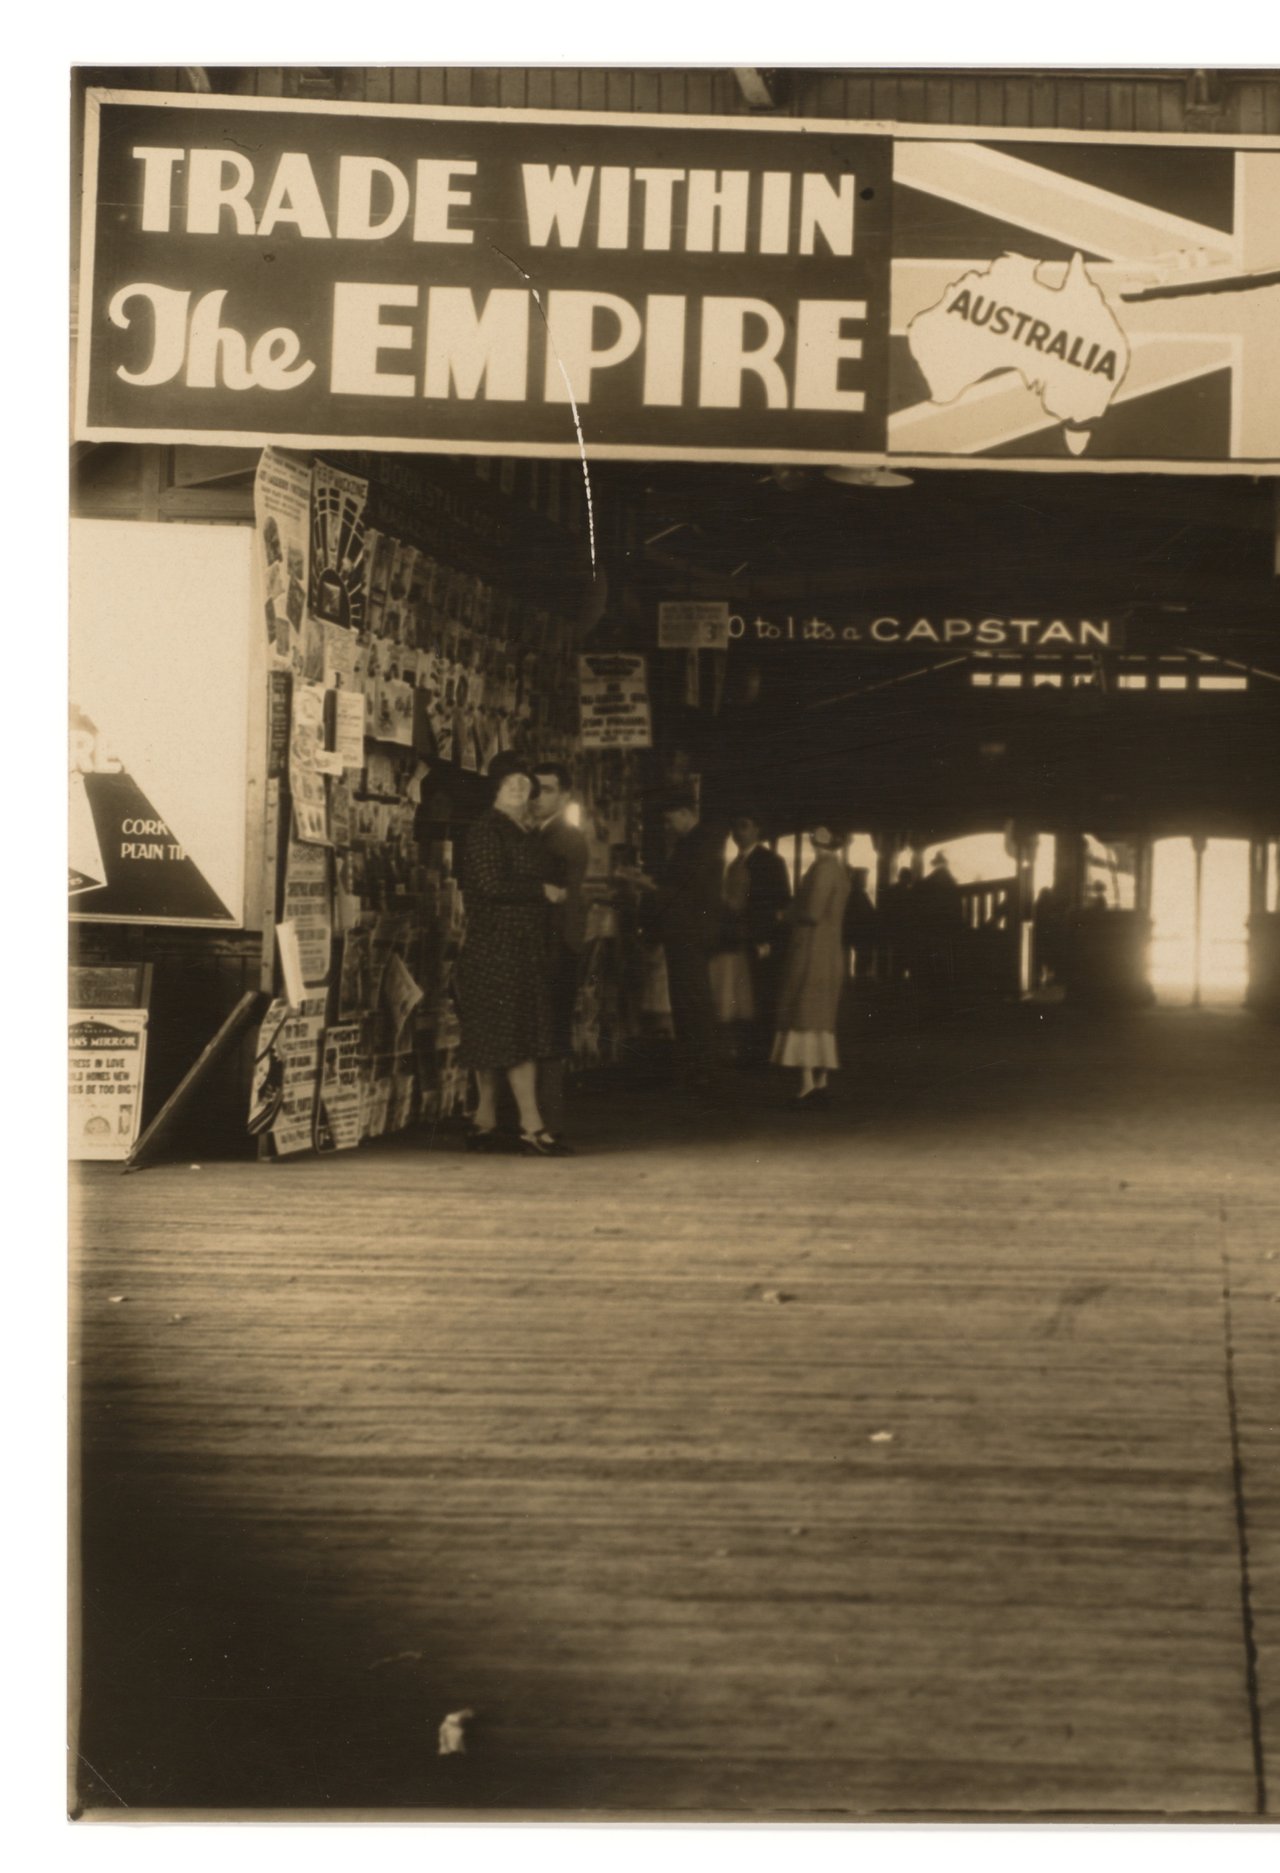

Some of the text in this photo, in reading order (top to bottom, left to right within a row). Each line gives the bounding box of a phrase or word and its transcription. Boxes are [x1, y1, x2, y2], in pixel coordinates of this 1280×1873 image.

[132, 146, 856, 256] TRADE WITHIN
[946, 288, 1118, 382] AUSTRALIA
[108, 281, 867, 412] The EMPIRE
[754, 616, 781, 640] to
[842, 626, 862, 641] a
[871, 617, 1110, 646] CAPSTAN
[121, 818, 169, 836] CORK
[121, 842, 163, 860] PLAIN
[91, 1036, 137, 1047] MIRROR
[95, 1058, 103, 1069] IN
[106, 1058, 126, 1069] LOVE
[86, 1084, 97, 1095] BE
[99, 1084, 115, 1095] TOO
